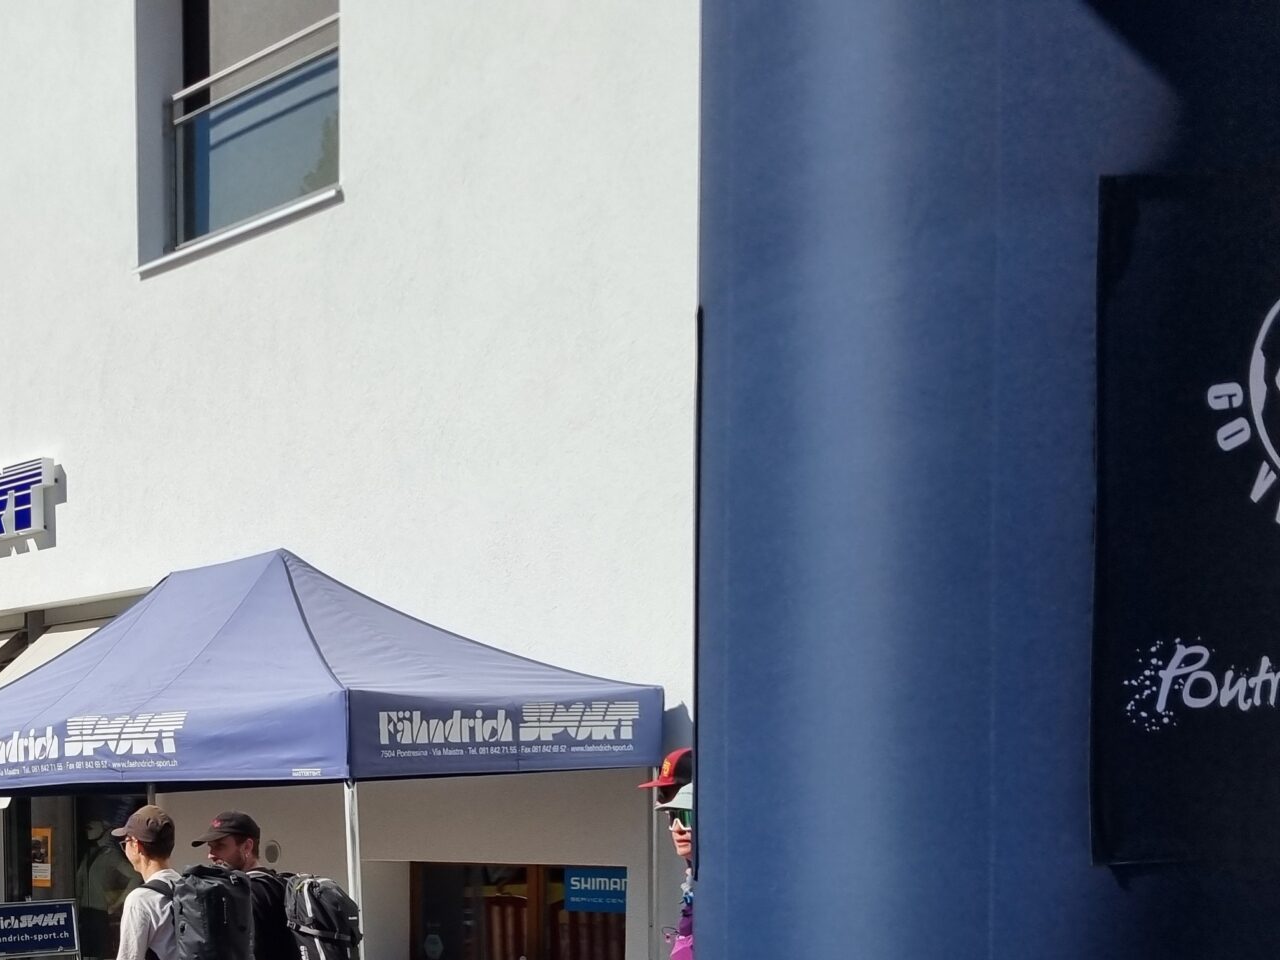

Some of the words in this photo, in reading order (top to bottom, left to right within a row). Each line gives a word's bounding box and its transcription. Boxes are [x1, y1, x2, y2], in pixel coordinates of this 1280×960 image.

[64, 711, 189, 757] SPORT
[378, 709, 513, 745] Fähndrich
[518, 701, 639, 742] SPORT
